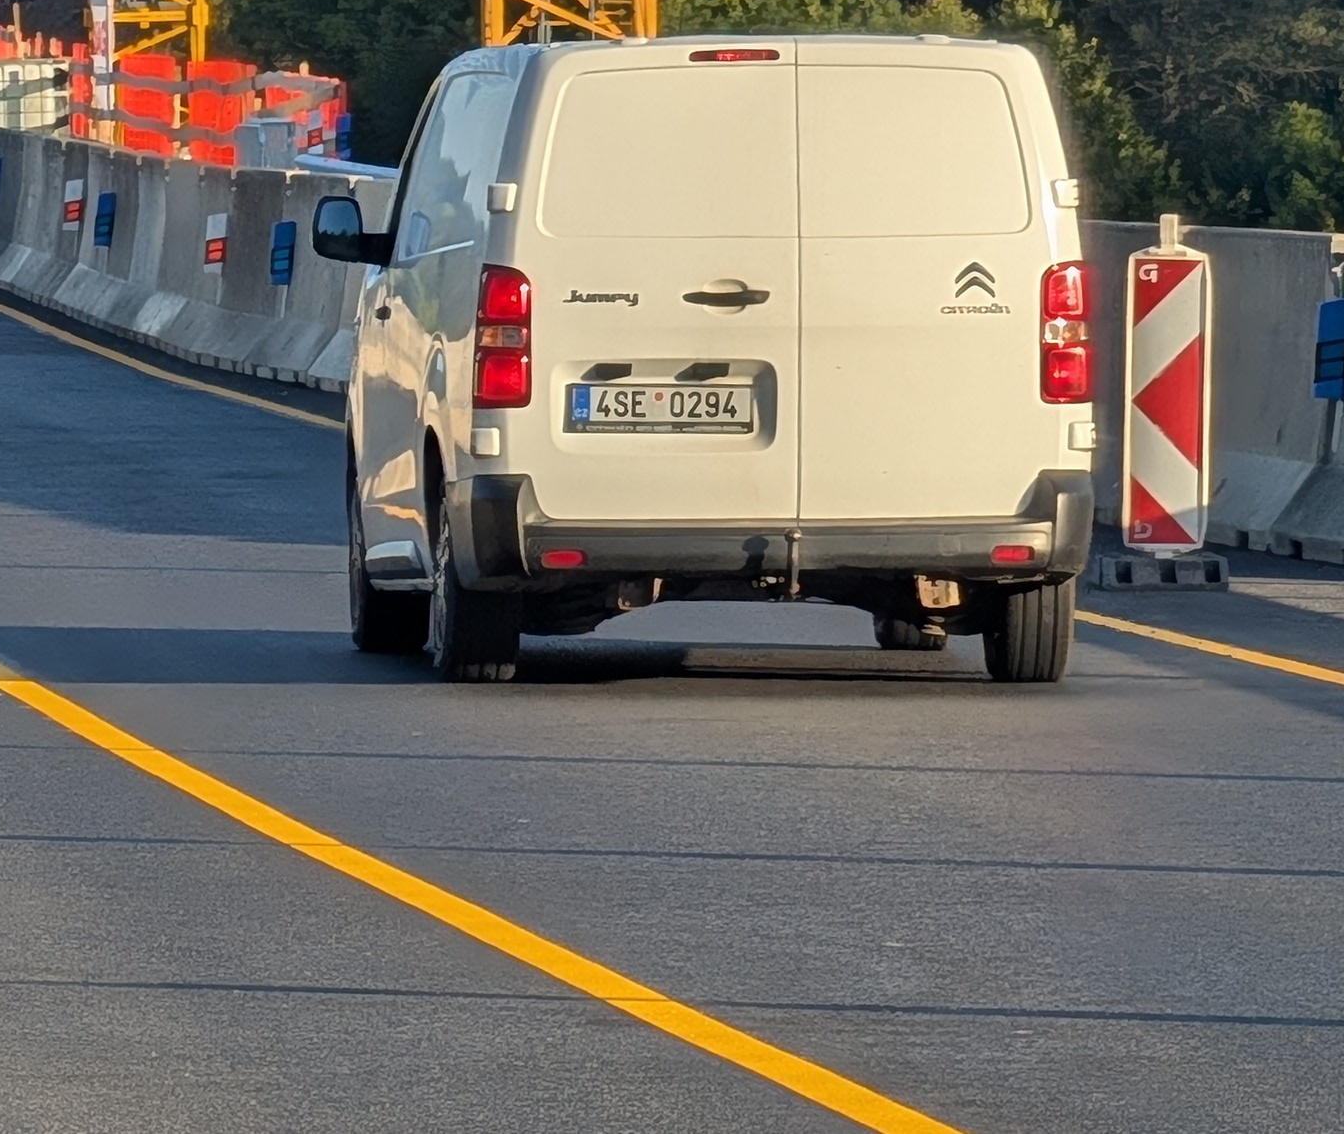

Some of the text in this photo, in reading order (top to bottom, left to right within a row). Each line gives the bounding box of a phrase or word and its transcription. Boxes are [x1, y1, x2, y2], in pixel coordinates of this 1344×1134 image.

[562, 290, 639, 307] Jumpy
[596, 390, 737, 418] 4SE 0294
